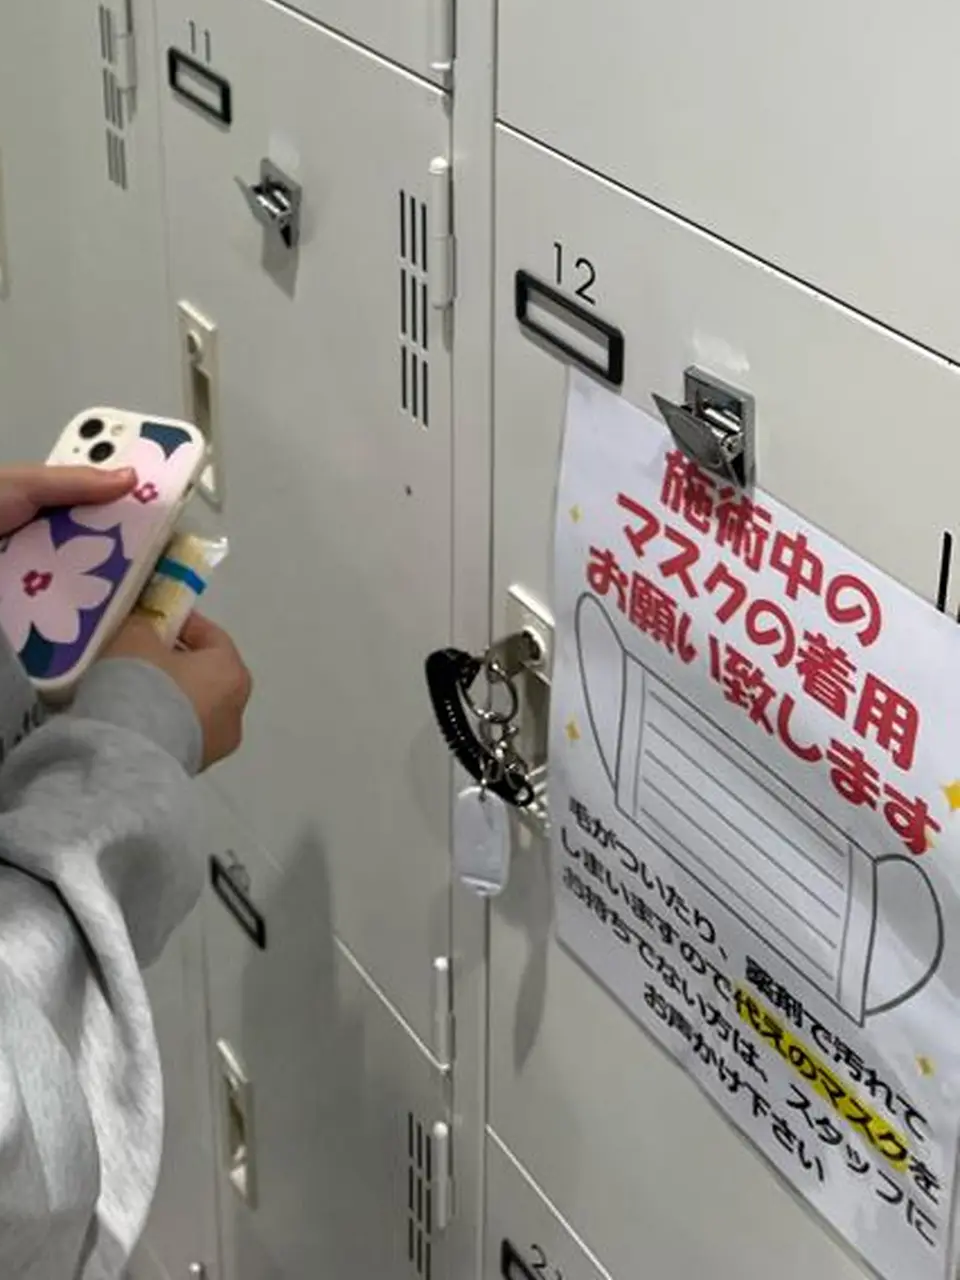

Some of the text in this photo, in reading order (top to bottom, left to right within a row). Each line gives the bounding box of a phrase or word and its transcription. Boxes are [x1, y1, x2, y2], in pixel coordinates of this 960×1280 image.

[188, 20, 211, 62] 11
[553, 241, 596, 305] 12
[616, 492, 920, 771] マスクの着用
[659, 449, 882, 647] 施術中の
[586, 546, 941, 856] お願い致します
